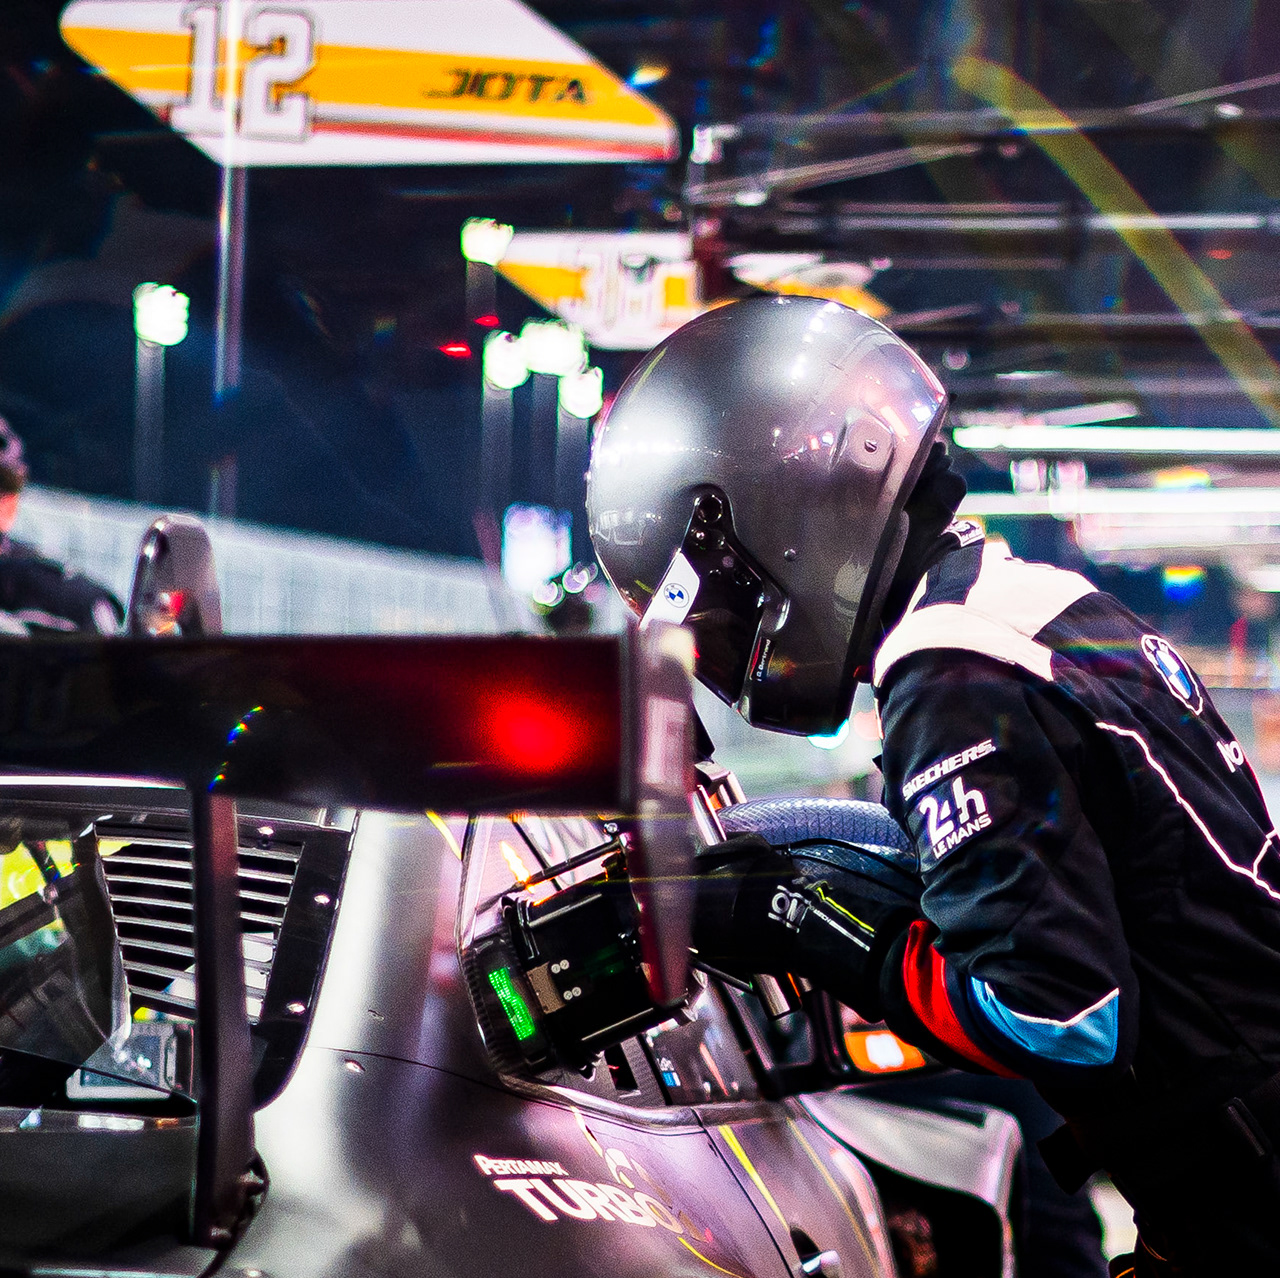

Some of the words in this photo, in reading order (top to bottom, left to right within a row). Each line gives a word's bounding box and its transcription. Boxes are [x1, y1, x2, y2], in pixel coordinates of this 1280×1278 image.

[171, 4, 317, 142] 12
[422, 67, 587, 104] JOTA
[902, 739, 993, 801] SKECHERS
[933, 840, 949, 859] LE
[946, 813, 992, 850] MANS
[474, 1154, 569, 1176] PERTAMAX
[493, 1178, 684, 1234] TURBO
